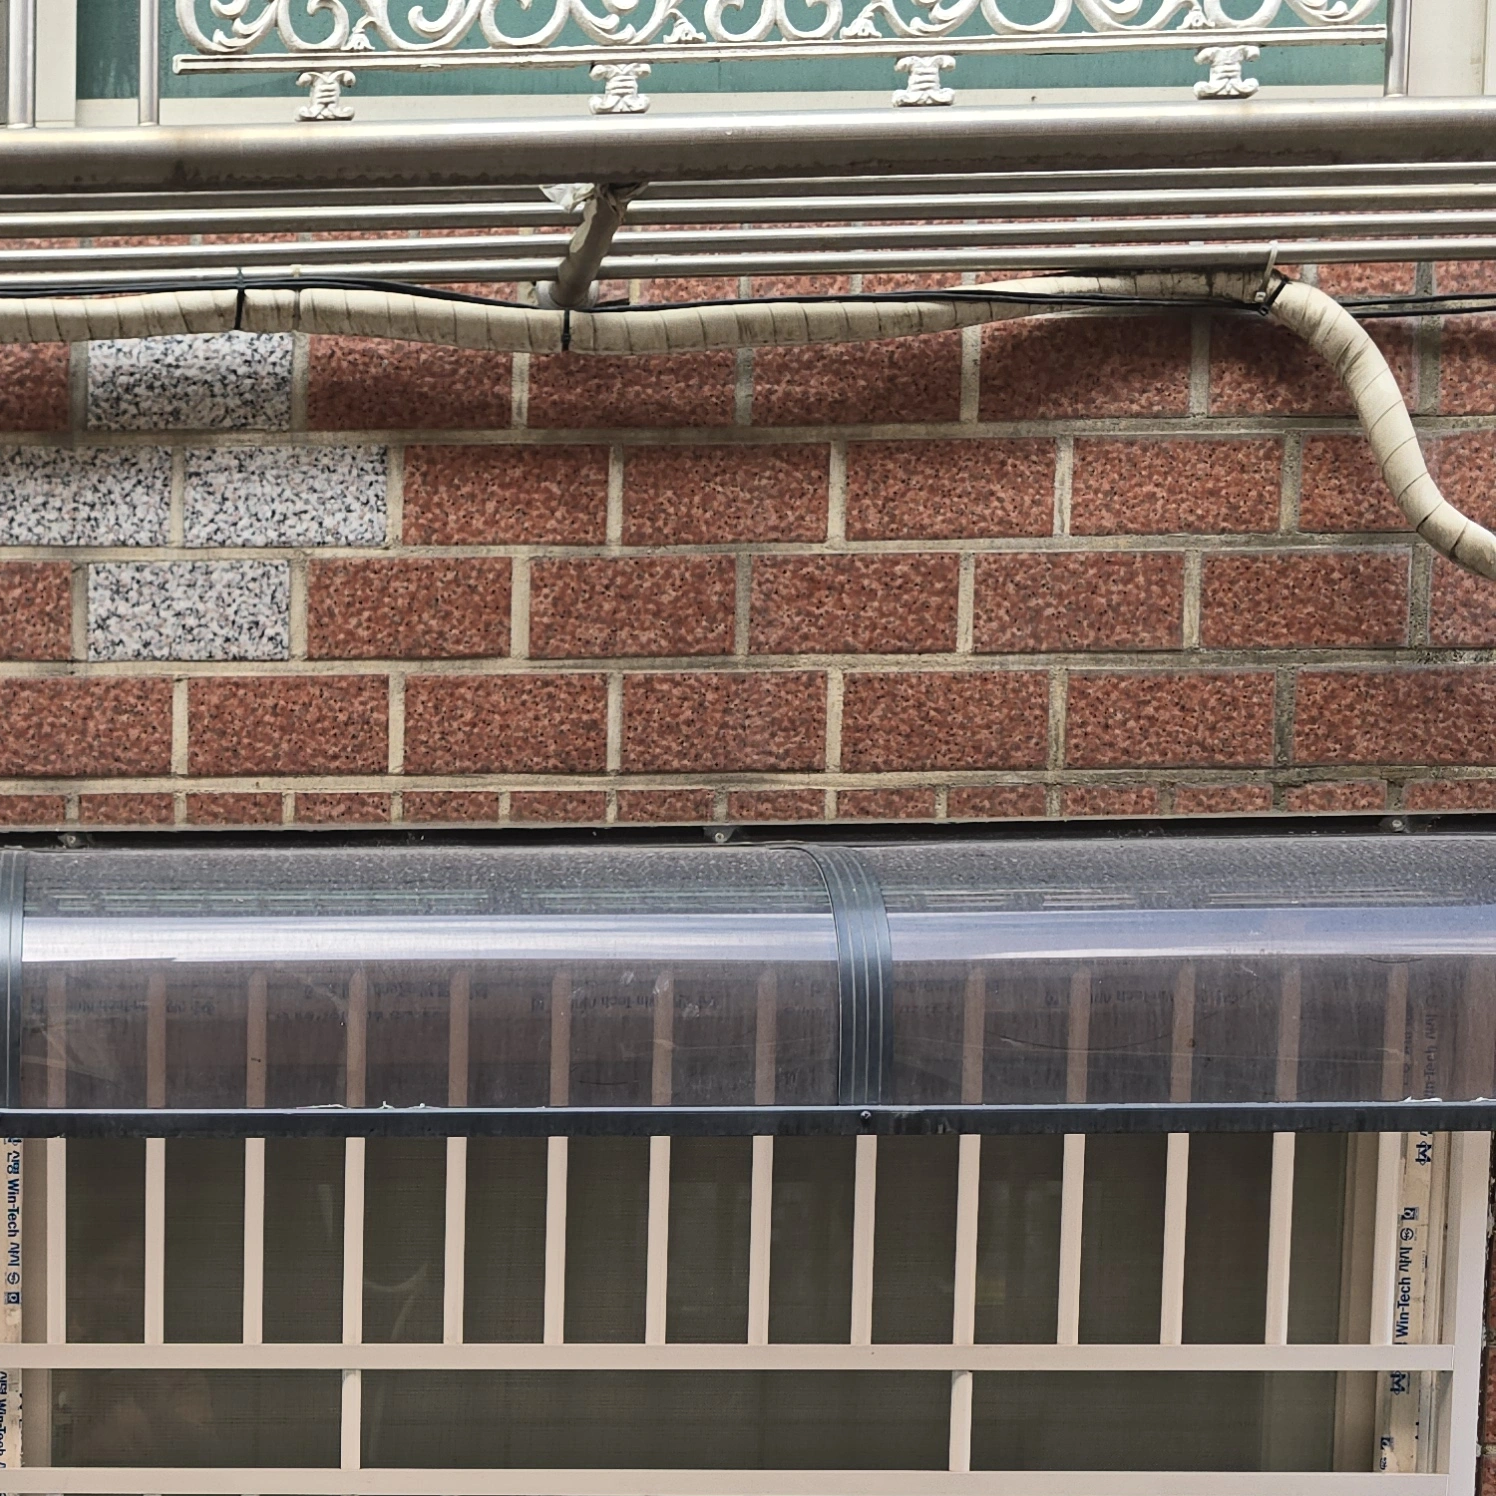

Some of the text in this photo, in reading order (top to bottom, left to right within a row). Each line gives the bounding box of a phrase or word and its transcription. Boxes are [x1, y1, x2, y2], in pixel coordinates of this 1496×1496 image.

[6, 1150, 20, 1175] 신명
[7, 1178, 20, 1238] Win-Tech
[9, 1242, 21, 1267] 샤시
[1399, 1246, 1413, 1272] 샤시
[1396, 1277, 1412, 1338] Win-Tech
